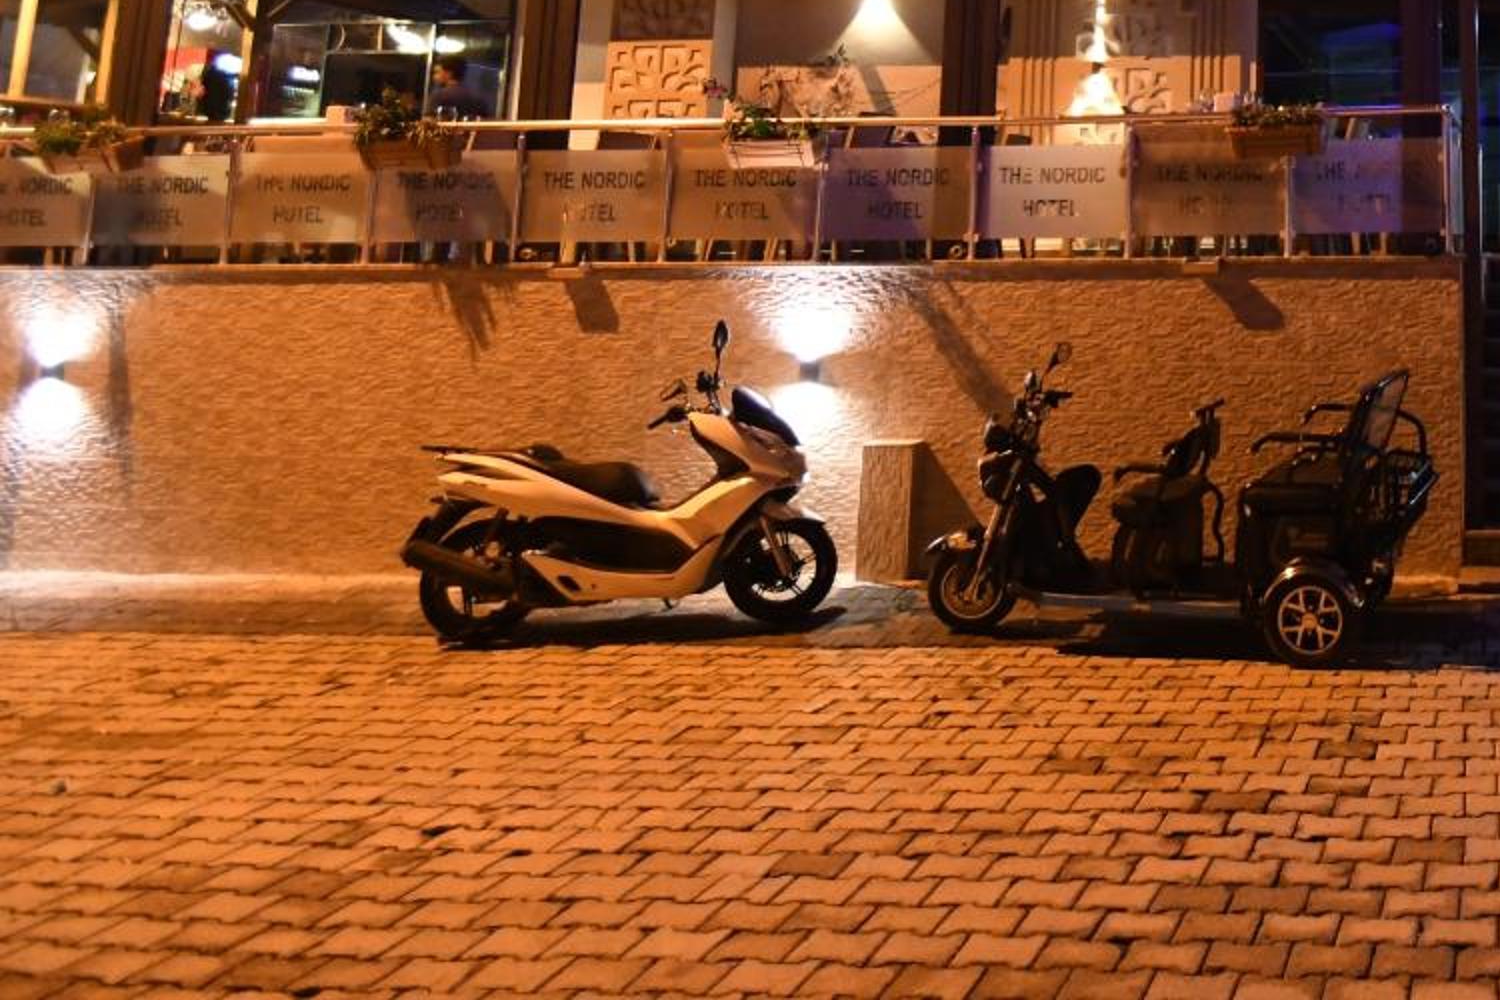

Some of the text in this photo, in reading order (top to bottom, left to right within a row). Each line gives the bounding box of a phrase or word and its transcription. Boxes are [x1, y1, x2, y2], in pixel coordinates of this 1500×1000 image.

[545, 171, 645, 189] THE NORDIC
[695, 169, 796, 187] THE NORDIC
[849, 167, 949, 186] THE NORDIC
[1000, 166, 1105, 185] THE NORDIC
[868, 201, 923, 219] HOTEL
[1024, 199, 1075, 217] HOTEL
